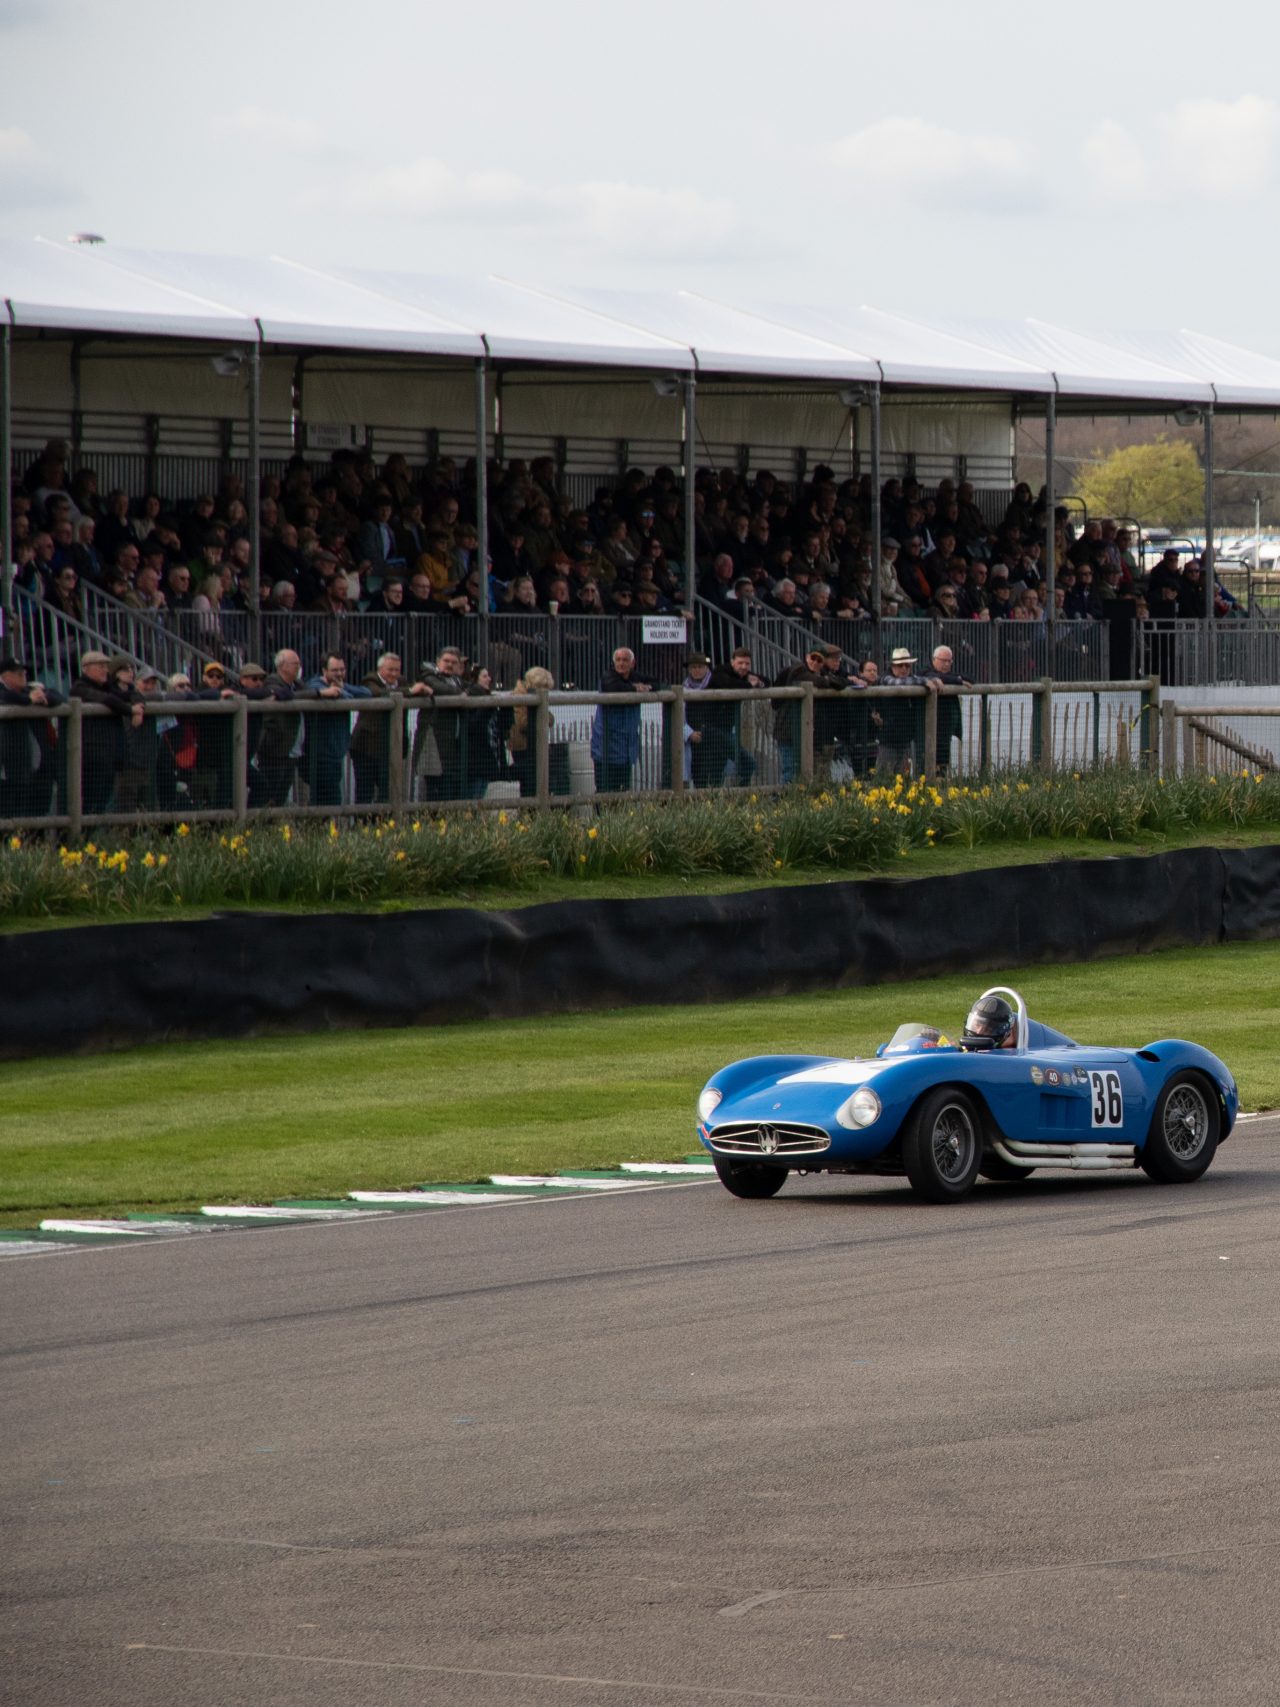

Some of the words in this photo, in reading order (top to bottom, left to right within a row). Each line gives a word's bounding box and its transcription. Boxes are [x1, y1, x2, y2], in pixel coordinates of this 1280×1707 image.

[645, 620, 671, 628] GRANDSTAND
[672, 620, 685, 628] TICKET
[650, 631, 668, 639] HOLDERS
[669, 631, 679, 639] ONLY
[1049, 1072, 1058, 1082] 40
[1092, 1072, 1122, 1124] 36
